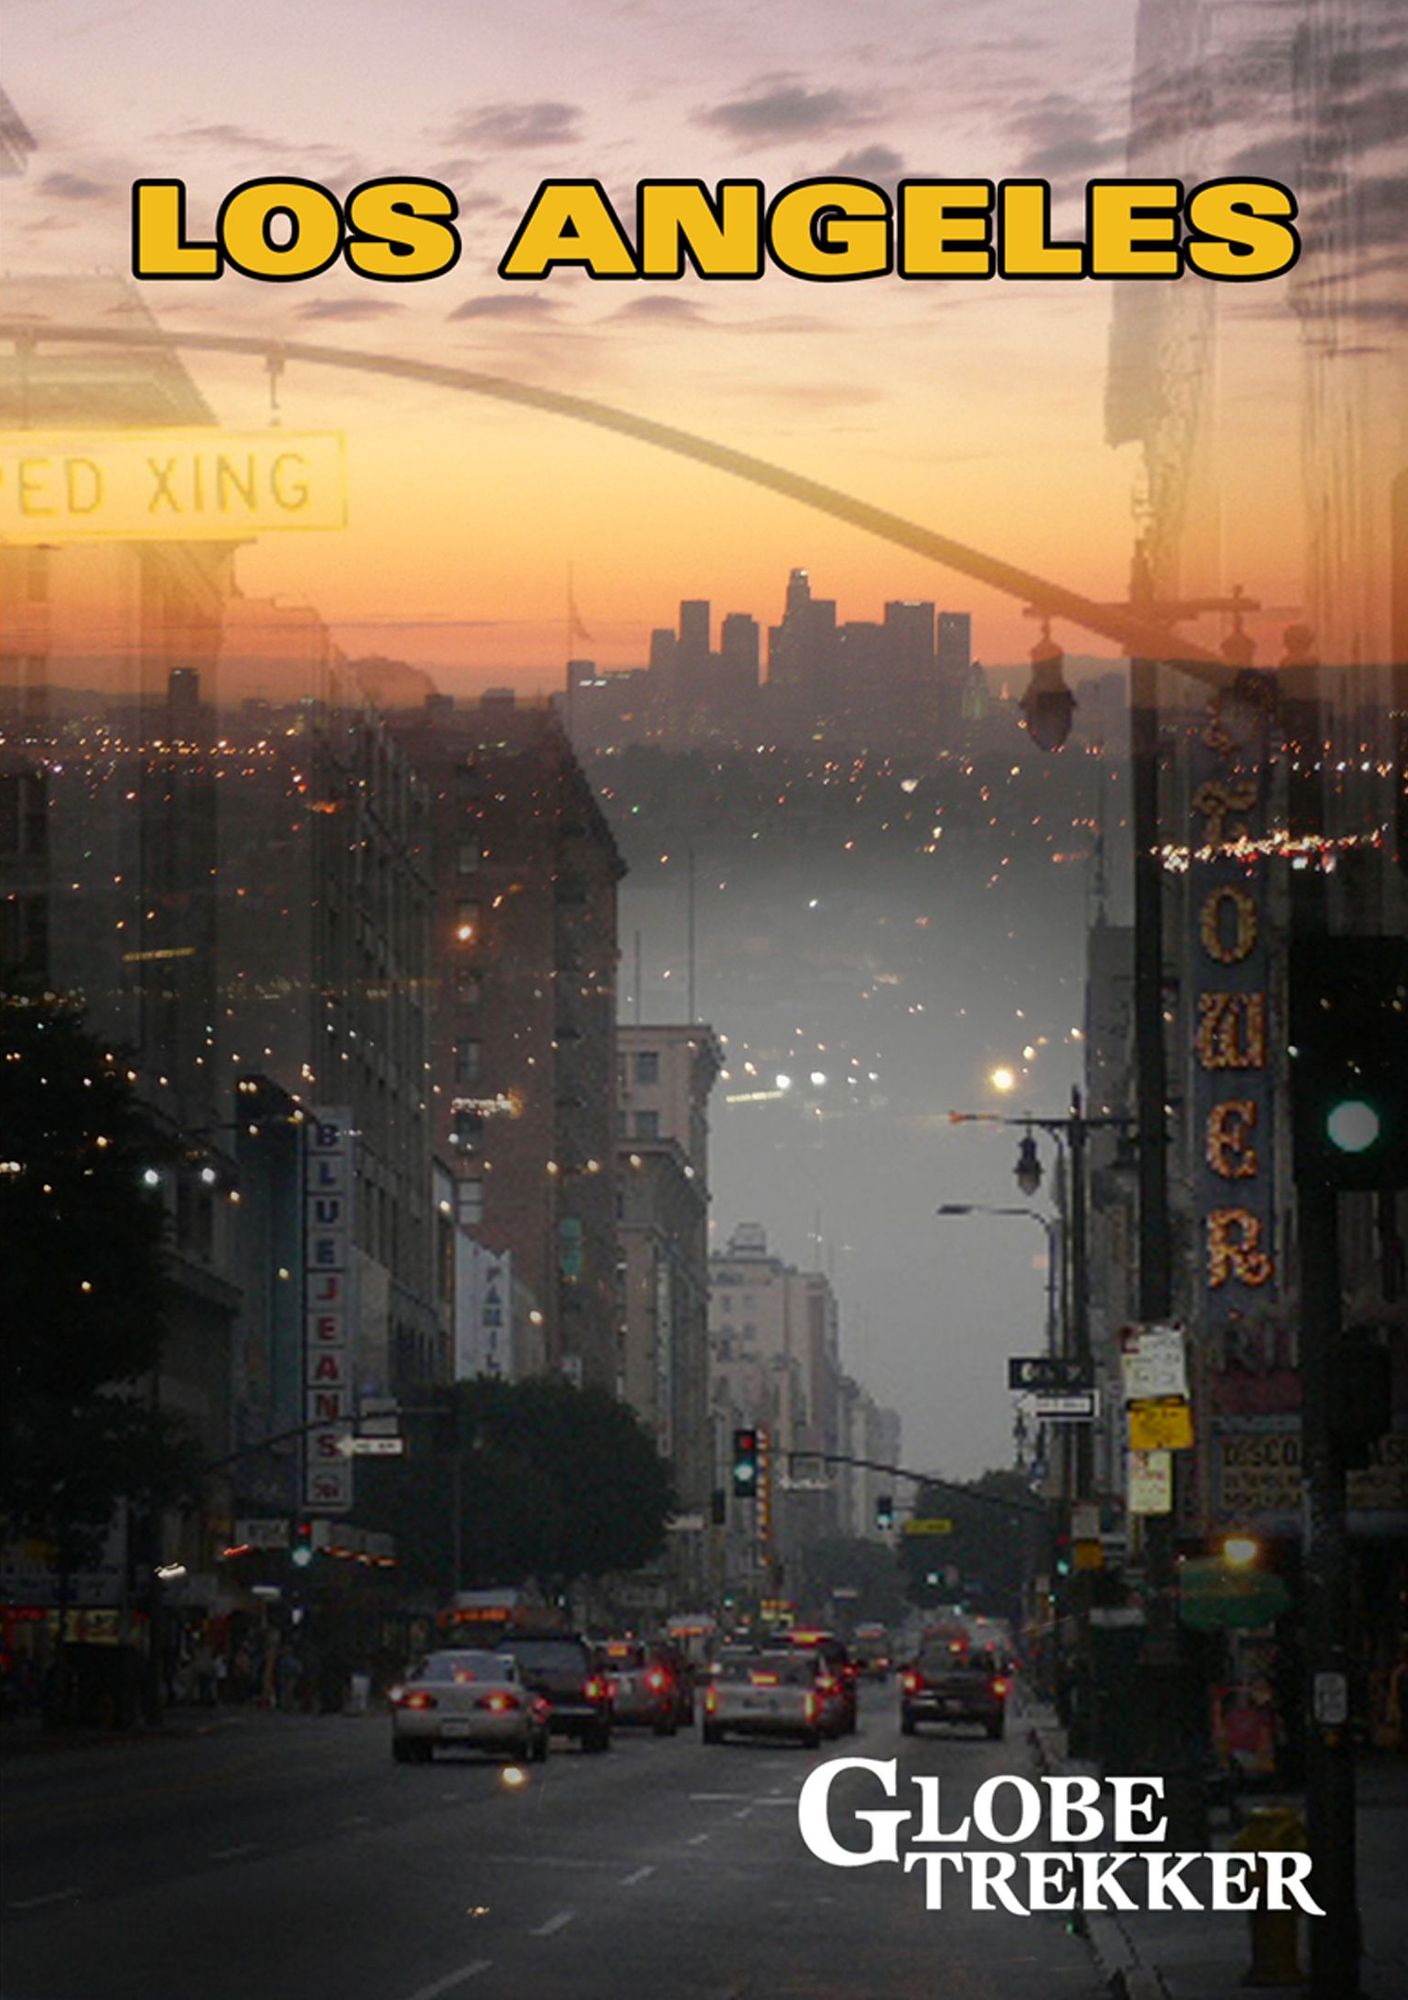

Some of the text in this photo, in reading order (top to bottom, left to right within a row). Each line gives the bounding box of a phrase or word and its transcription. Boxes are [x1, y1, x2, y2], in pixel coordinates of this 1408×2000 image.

[0, 452, 310, 517] ED XING
[316, 1122, 340, 1265] BLUE
[316, 1276, 340, 1458] JEANS
